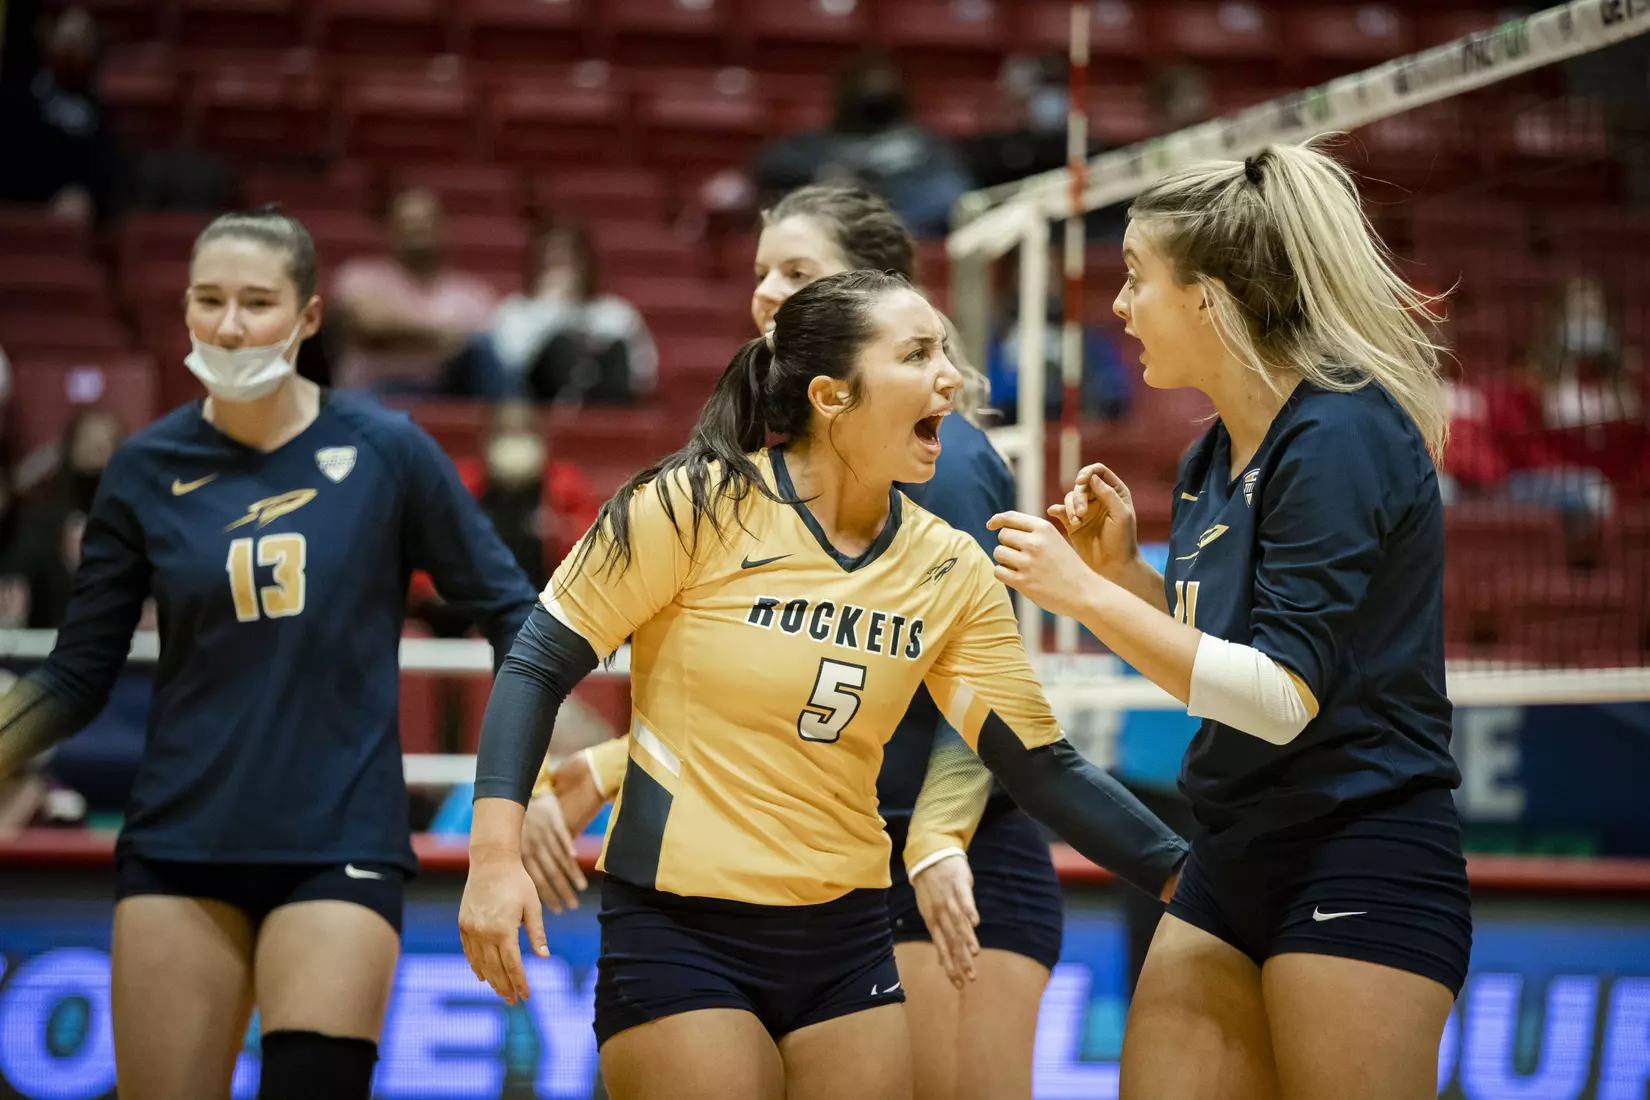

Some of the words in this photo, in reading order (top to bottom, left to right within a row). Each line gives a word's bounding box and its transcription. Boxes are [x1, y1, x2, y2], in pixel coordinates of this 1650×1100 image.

[226, 532, 307, 623] 13
[745, 596, 925, 661] ROCKETS
[797, 657, 867, 743] 5
